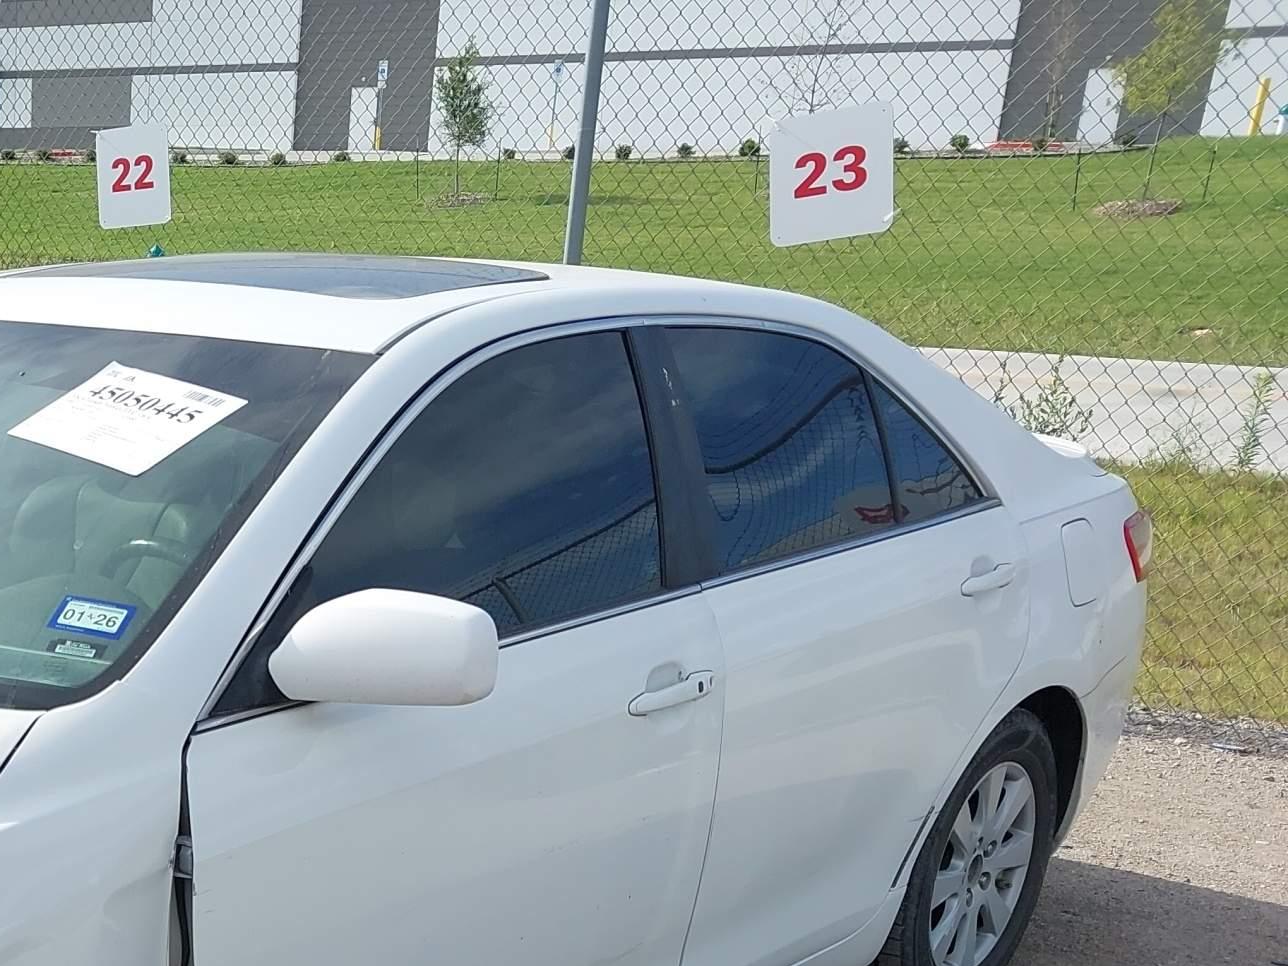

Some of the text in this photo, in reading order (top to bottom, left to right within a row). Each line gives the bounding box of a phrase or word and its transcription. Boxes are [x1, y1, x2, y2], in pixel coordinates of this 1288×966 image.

[111, 154, 155, 193] 22
[792, 144, 868, 199] 23
[89, 384, 204, 424] 45050445
[62, 608, 86, 622] 01
[92, 613, 119, 628] 26
